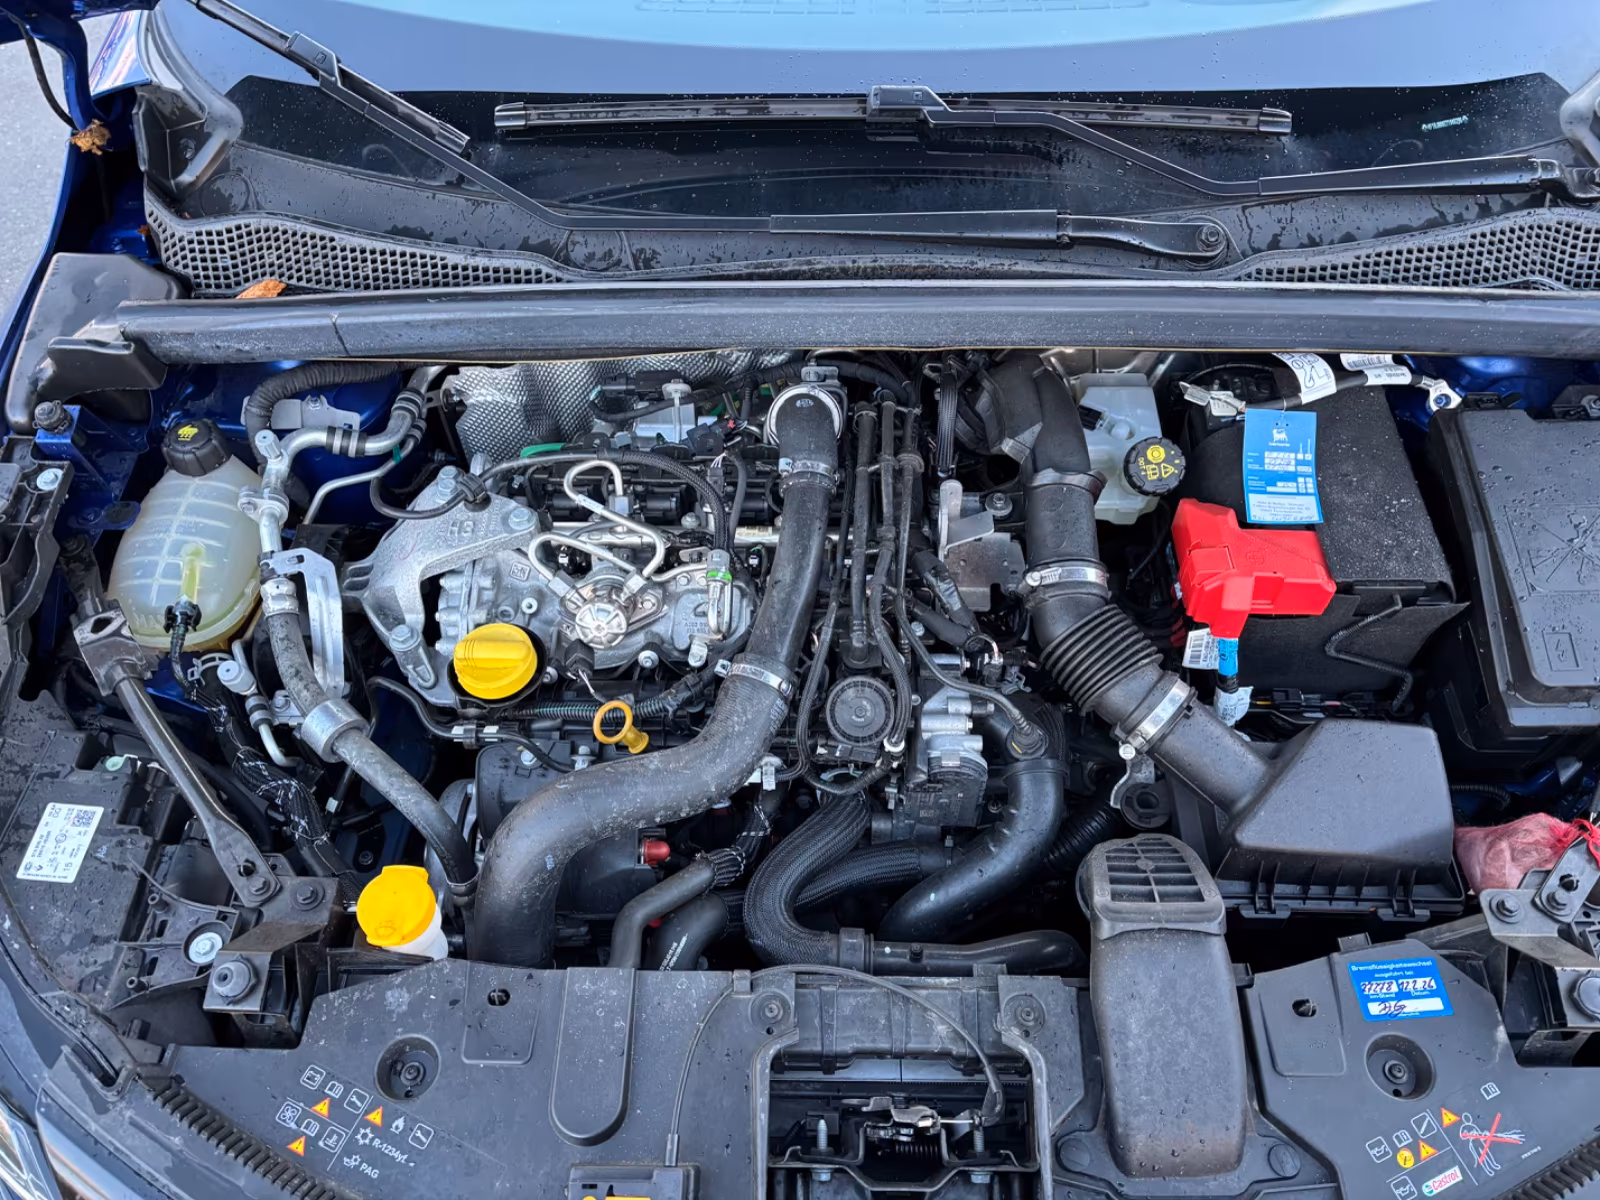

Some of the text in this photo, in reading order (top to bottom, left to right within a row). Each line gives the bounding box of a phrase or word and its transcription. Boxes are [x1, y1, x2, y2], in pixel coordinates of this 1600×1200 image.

[1351, 960, 1433, 971] Bremsflüssigkeitswechsel
[372, 1138, 409, 1164] R-1234yf
[359, 1162, 380, 1179] PAG
[1432, 1169, 1460, 1191] Castrol
